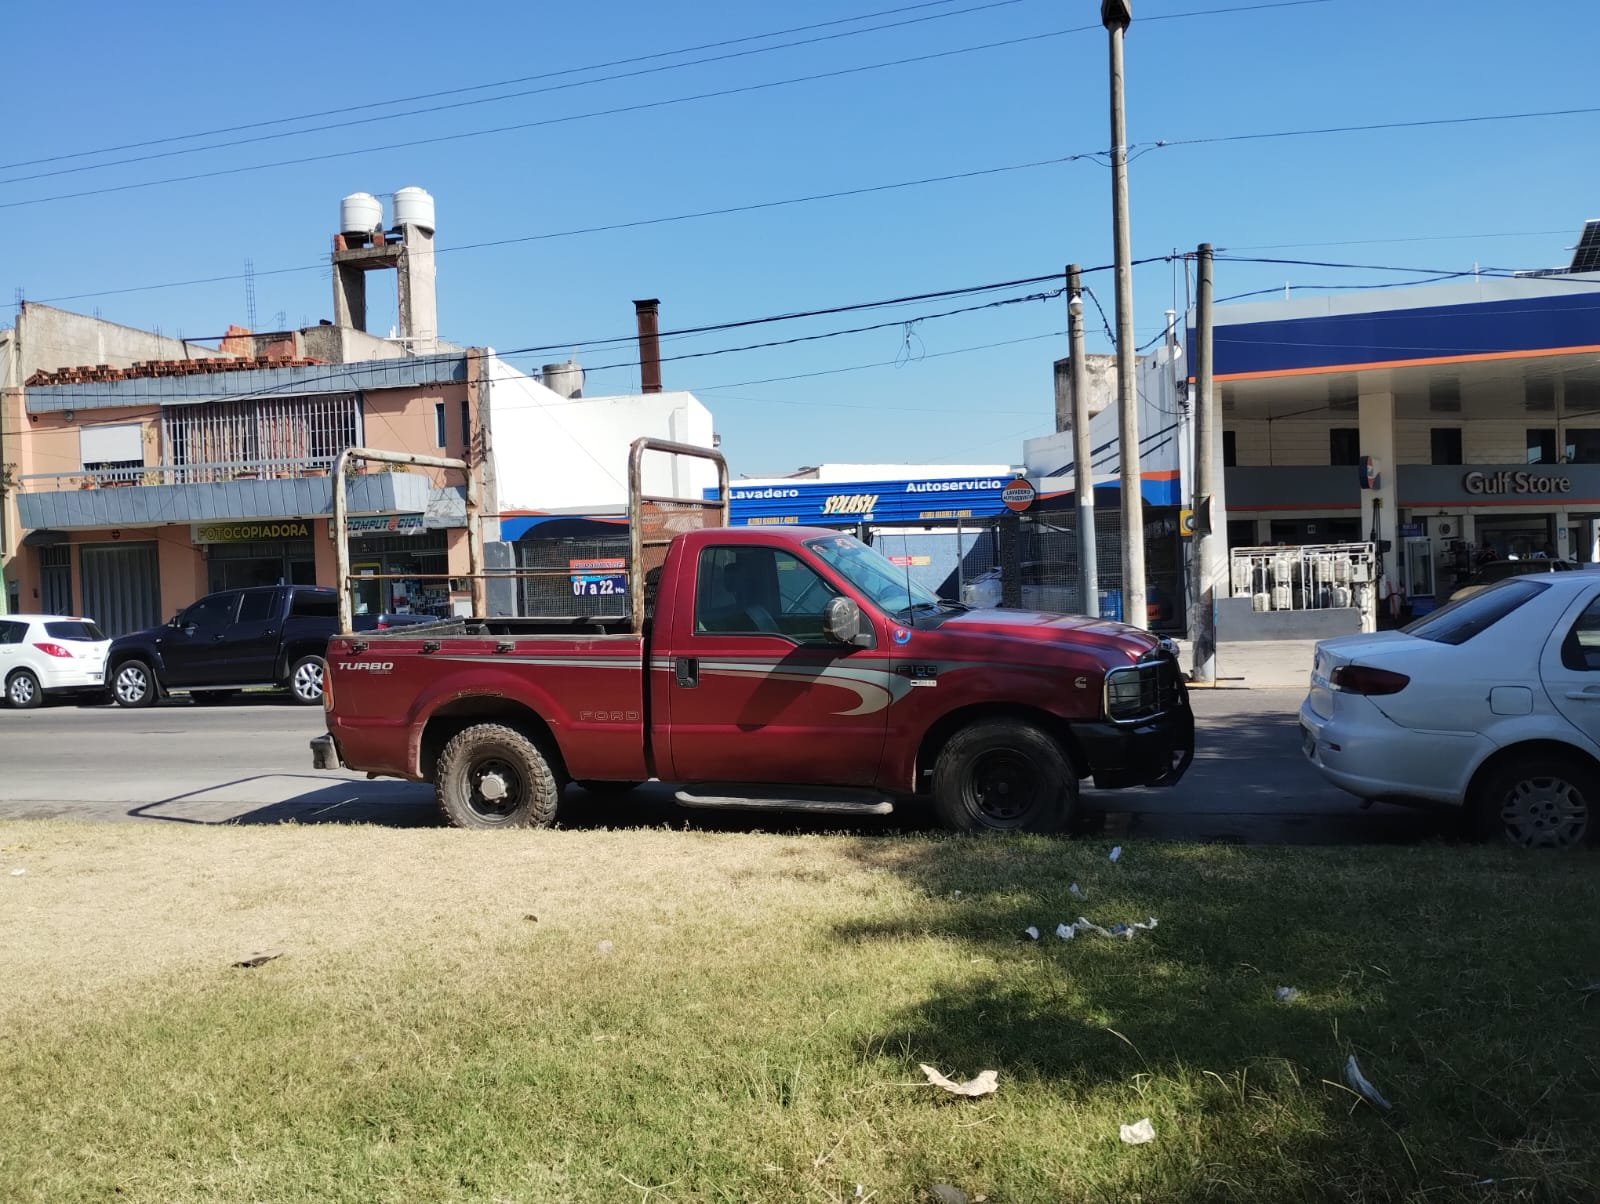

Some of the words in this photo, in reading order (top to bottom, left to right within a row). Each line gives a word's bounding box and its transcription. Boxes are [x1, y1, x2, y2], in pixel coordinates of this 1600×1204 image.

[905, 478, 1002, 493] Autoservicio
[1464, 471, 1512, 494] Gulf
[1514, 471, 1571, 493] Store
[728, 488, 799, 500] Lavadero
[822, 494, 879, 515] SPLASH
[199, 524, 308, 540] FOTOCOPIADORA
[573, 581, 587, 596] 07
[590, 584, 597, 595] a
[600, 580, 614, 595] 22
[338, 662, 394, 671] TURBO
[580, 710, 640, 721] FORD
